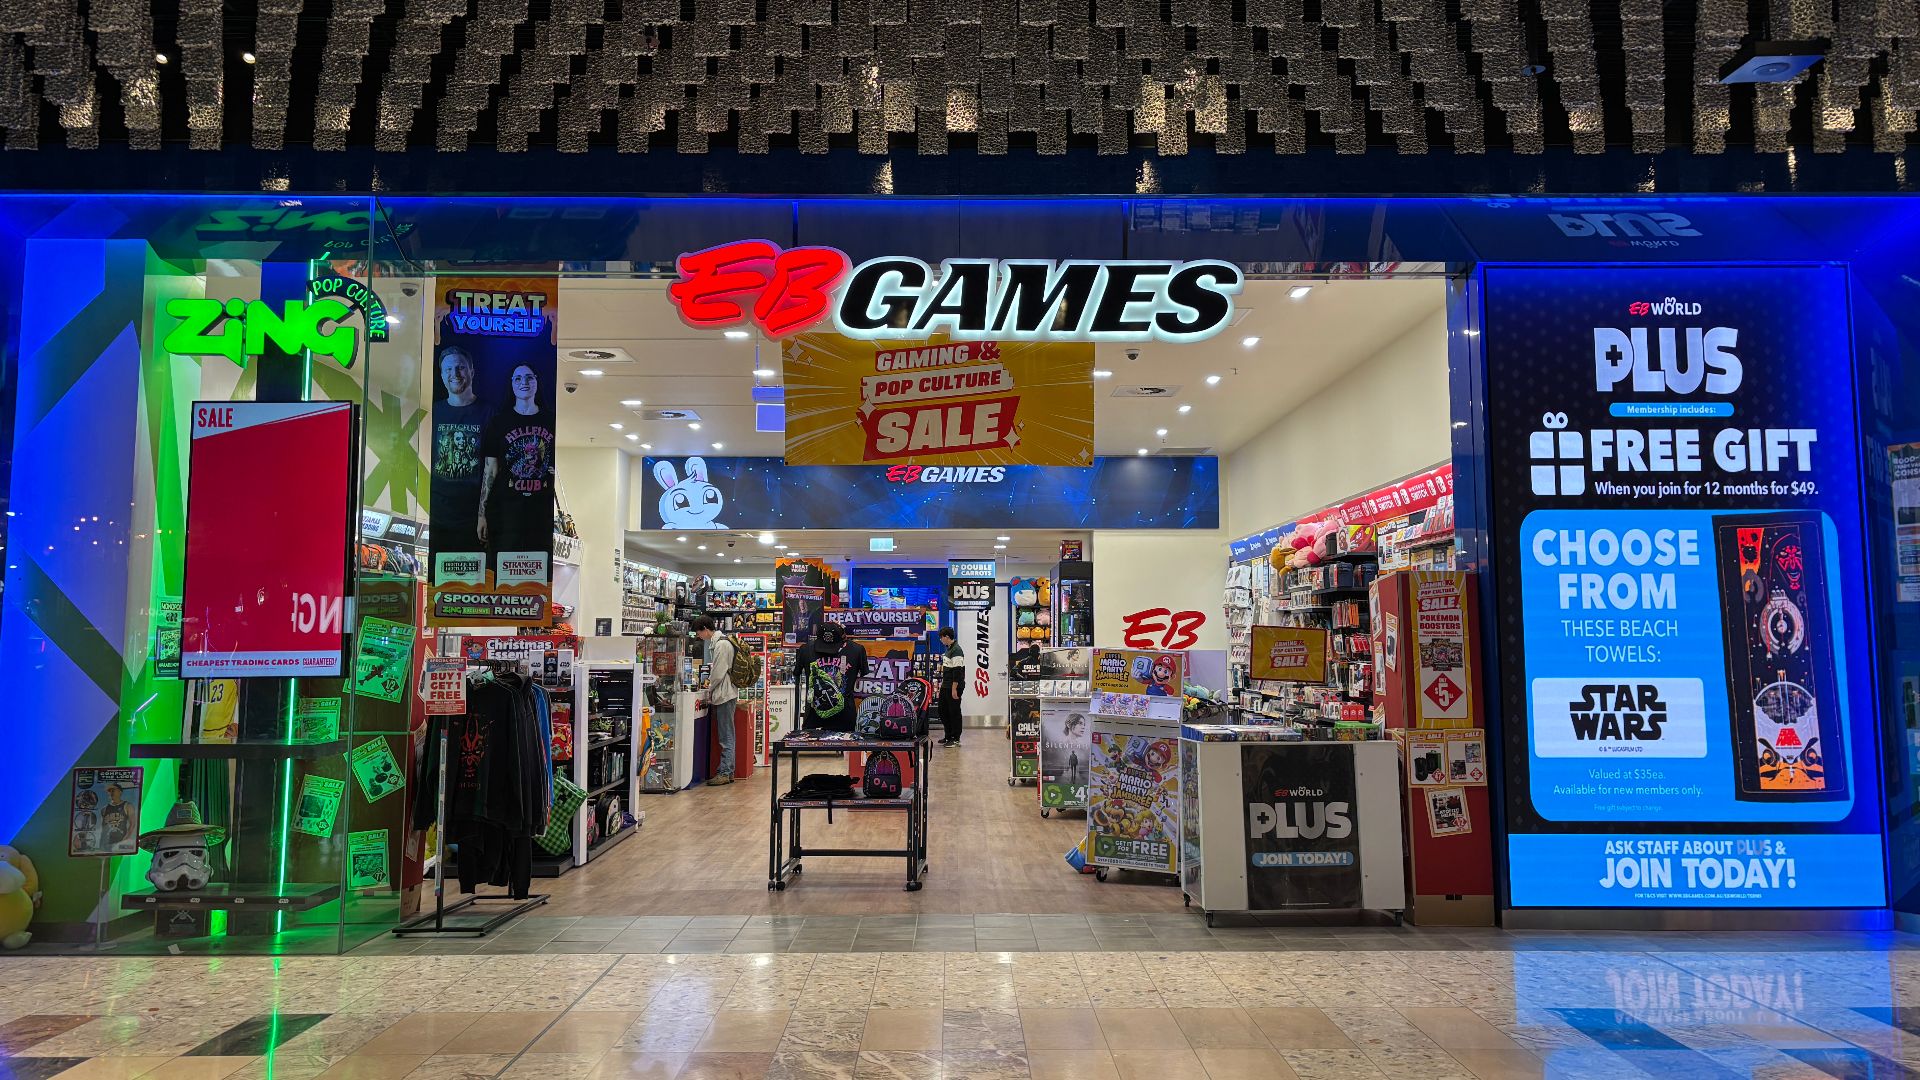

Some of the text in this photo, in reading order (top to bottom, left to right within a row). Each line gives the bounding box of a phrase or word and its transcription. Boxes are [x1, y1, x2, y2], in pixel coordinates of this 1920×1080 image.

[670, 241, 1238, 334] EB GAMES
[312, 278, 386, 339] POP CULTURE
[456, 292, 545, 316] TREAT
[1629, 297, 1701, 316] EB WORLD
[455, 315, 541, 333] YOURSELF
[876, 341, 1000, 371] GAMING &
[1593, 326, 1743, 394] PLUS
[875, 369, 1001, 396] POP CULTURE
[198, 407, 233, 427] SALE
[1626, 404, 1716, 416] Membership includes:
[505, 426, 553, 444] HELLFIRE
[876, 402, 1001, 453] SALE
[1590, 427, 1818, 473] FREE GIFT
[885, 464, 1006, 483] EB GAMES
[514, 480, 542, 491] CLUB
[1595, 480, 1818, 498] When you join for 12 months for $49.
[1411, 489, 1429, 501] SWITCH
[1532, 528, 1700, 566] CHOOSE
[502, 561, 542, 571] STRANGER
[953, 586, 990, 599] PLUS
[1559, 572, 1677, 610] FROM
[443, 594, 534, 605] SPOOKY NEW
[1422, 596, 1456, 611] SALE
[494, 606, 537, 616] RANGE
[824, 611, 918, 623] TREAT YOURSELF
[1420, 613, 1459, 622] POKÉMON
[1122, 608, 1206, 650] EB
[1561, 619, 1678, 637] THESE BEACH
[486, 639, 552, 650] Christmas
[1273, 655, 1305, 667] SALE
[1585, 644, 1661, 663] TOWELS:
[186, 659, 230, 667] CHEAPEST
[231, 658, 270, 666] TRADING
[1100, 658, 1127, 667] MARIO
[1101, 665, 1124, 673] PARTY
[430, 672, 462, 681] BUY 1
[974, 667, 990, 698] EB
[1096, 670, 1129, 682] JAMBOREE
[211, 683, 223, 703] 23
[430, 681, 461, 690] GET 1
[430, 690, 461, 700] FREE
[1569, 684, 1666, 712] STAR
[1018, 723, 1035, 731] CALL
[1570, 712, 1667, 741] WARS
[1119, 773, 1152, 788] MARIO
[1127, 768, 1151, 778] SUPER
[1589, 768, 1666, 780] Valued at $35ea.
[1110, 786, 1153, 808] JAMBOREE
[1120, 782, 1146, 796] PARTY
[1274, 787, 1323, 797] EB WORLD
[1553, 784, 1704, 797] Available for new members only.
[1249, 801, 1352, 839] PLUS
[1132, 841, 1168, 857] FREE
[1605, 840, 1786, 856] ASK STAFF ABOUT PLUS &
[1260, 852, 1347, 865] JOIN TODAY!
[1599, 857, 1796, 889] JOIN TODAY!
